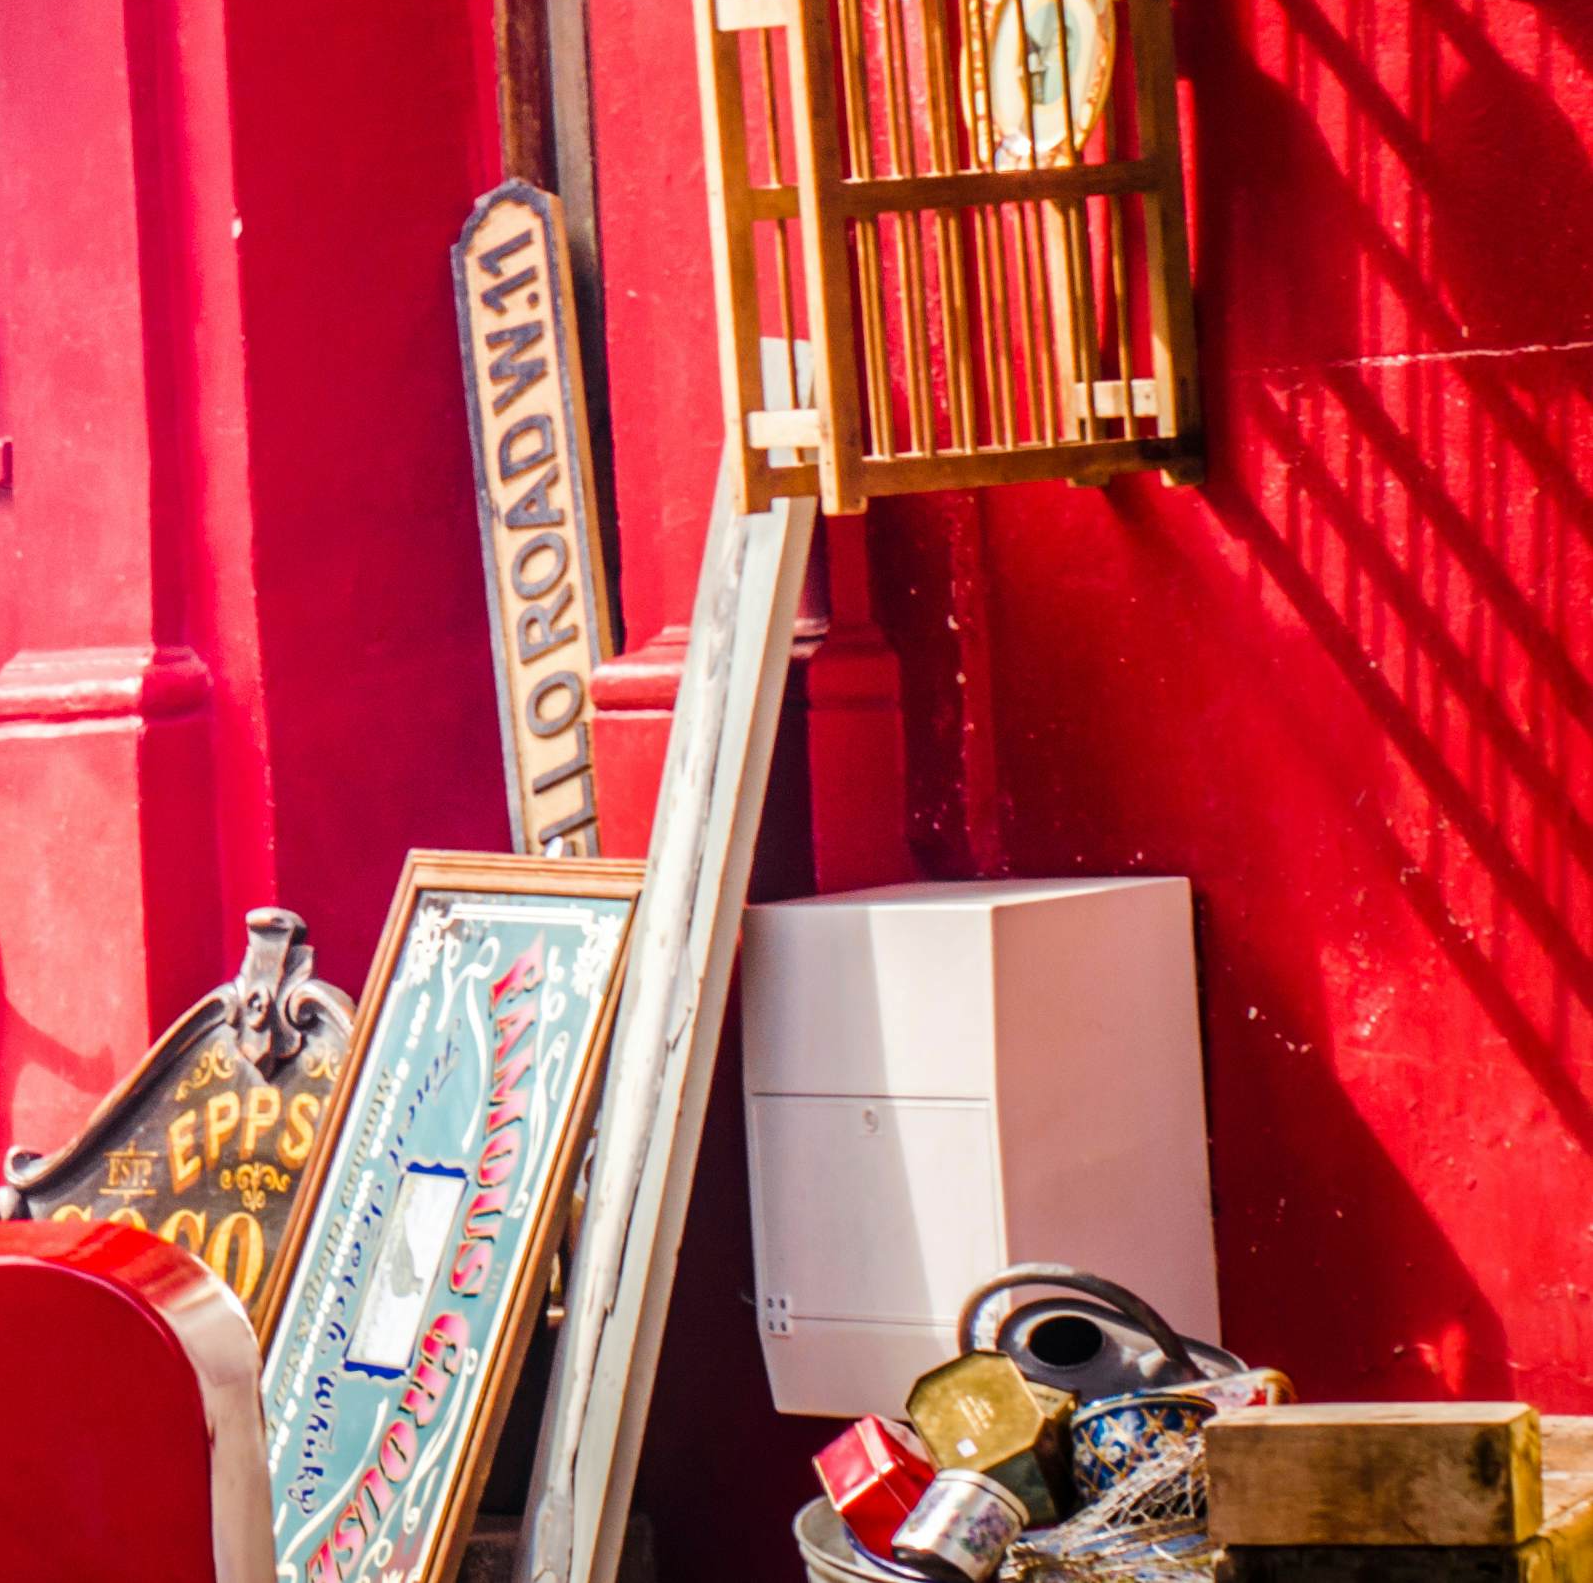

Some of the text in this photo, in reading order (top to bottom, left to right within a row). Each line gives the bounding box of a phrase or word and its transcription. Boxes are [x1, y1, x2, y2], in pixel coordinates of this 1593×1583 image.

[477, 225, 550, 417] W.11
[499, 413, 582, 664] ROAD
[450, 929, 546, 1299] FAMOUS
